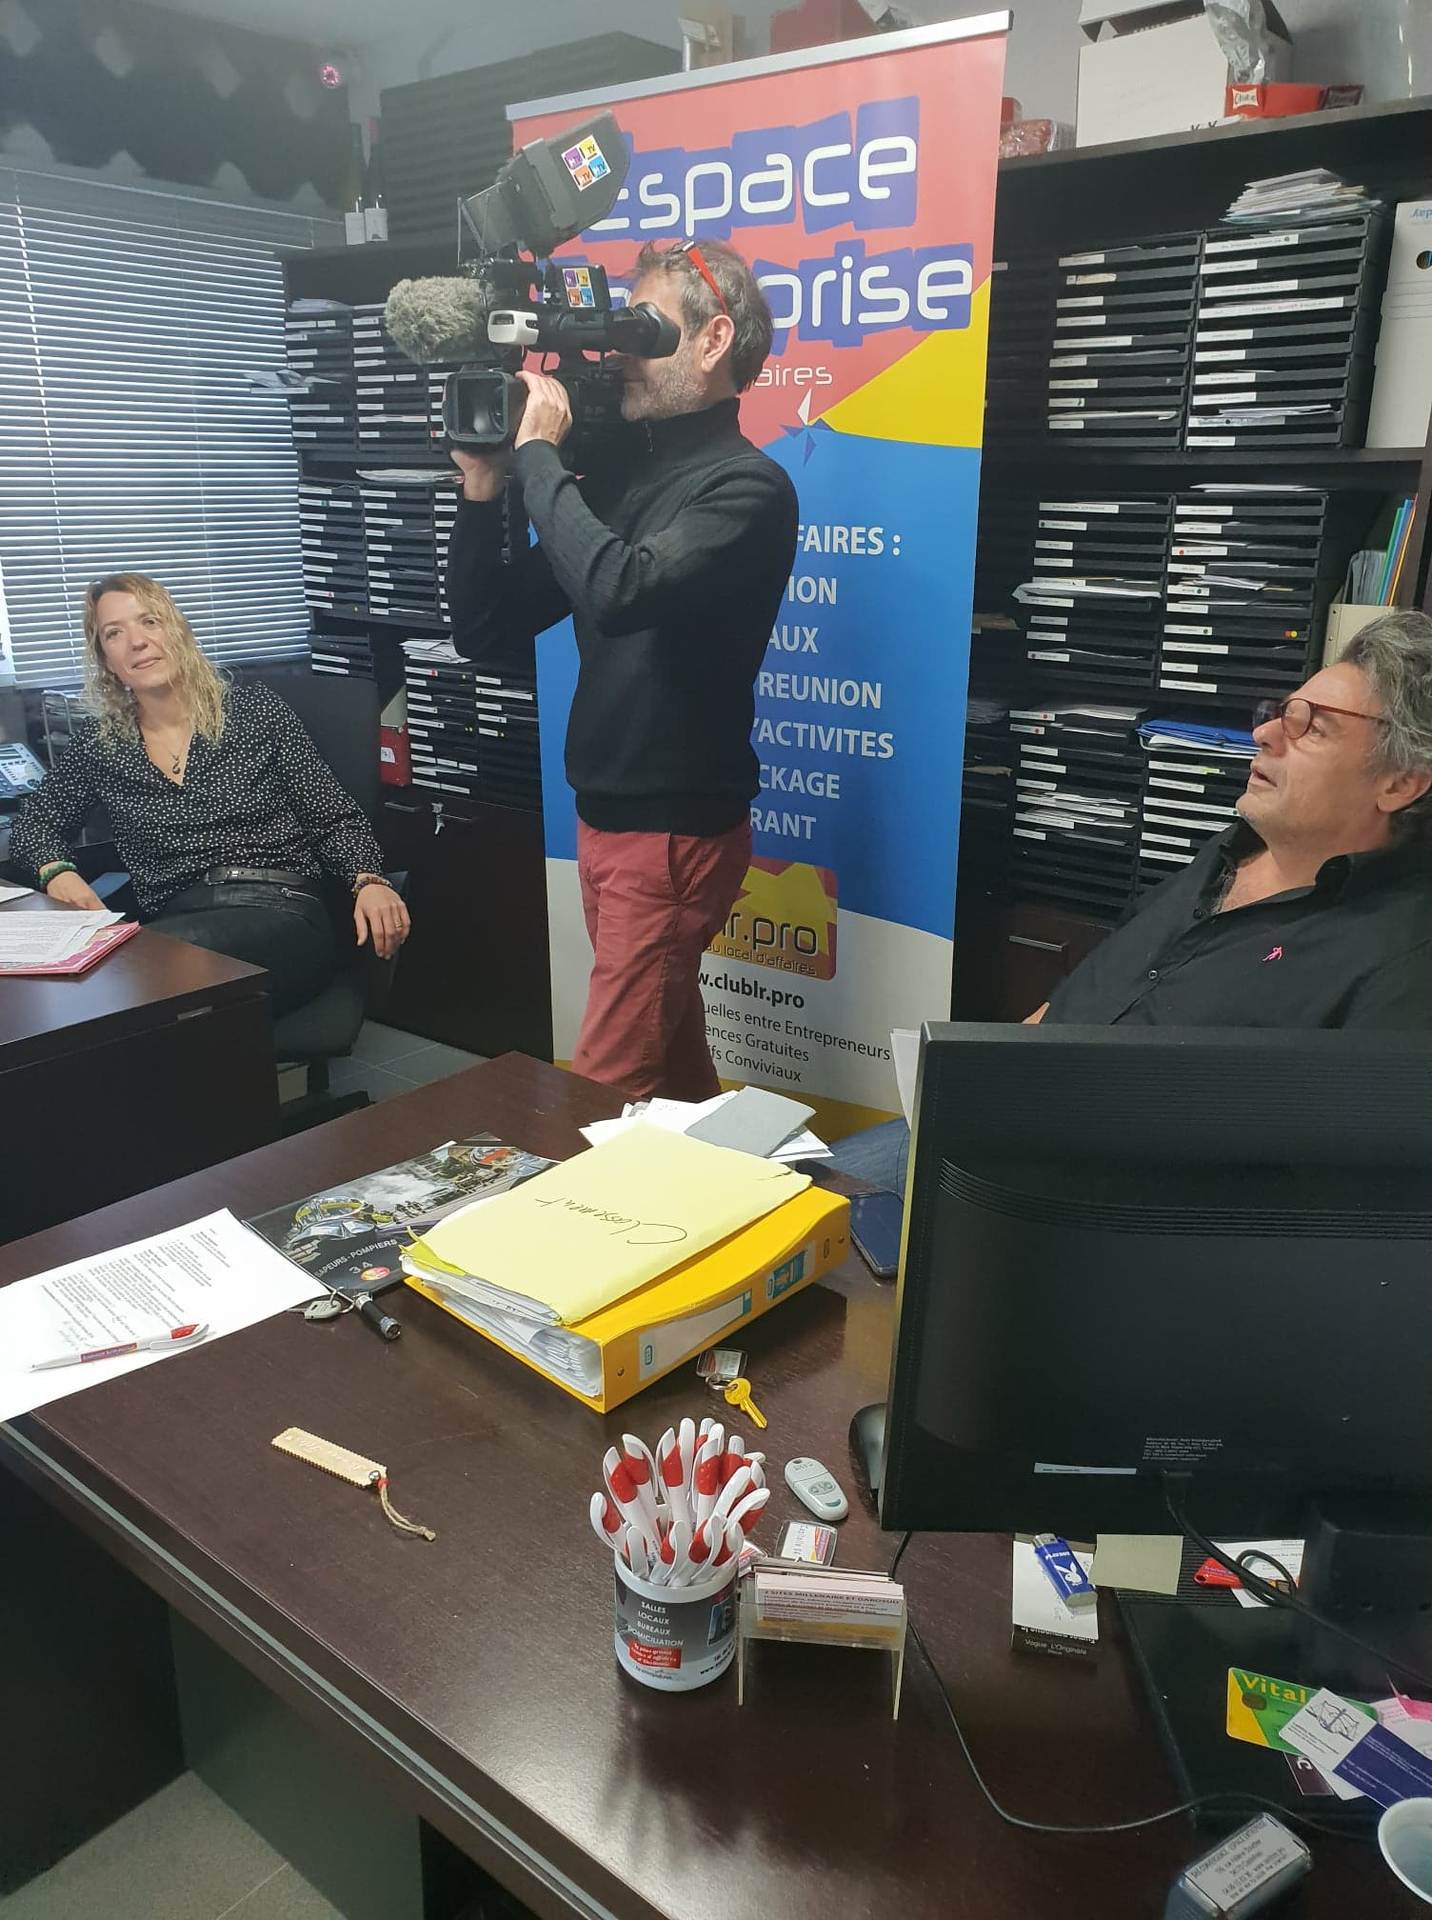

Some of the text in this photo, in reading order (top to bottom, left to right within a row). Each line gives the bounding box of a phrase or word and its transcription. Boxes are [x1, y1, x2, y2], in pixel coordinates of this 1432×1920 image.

[788, 575, 837, 605] ION
[769, 624, 819, 653] AUX
[759, 671, 882, 709] REUNION
[758, 764, 841, 800] CKAGE
[750, 807, 817, 840] RANT
[722, 912, 819, 957] r.pro
[744, 1012, 782, 1032] entre
[785, 1020, 891, 1061] Entrepreneurs
[745, 1033, 810, 1062] Gratuites
[709, 1045, 803, 1083] fs Conviviaux
[638, 1610, 670, 1625] LOCAUX
[641, 1601, 666, 1614] SALLES
[637, 1621, 671, 1636] BUREAUX
[1241, 1673, 1306, 1704] Vital
